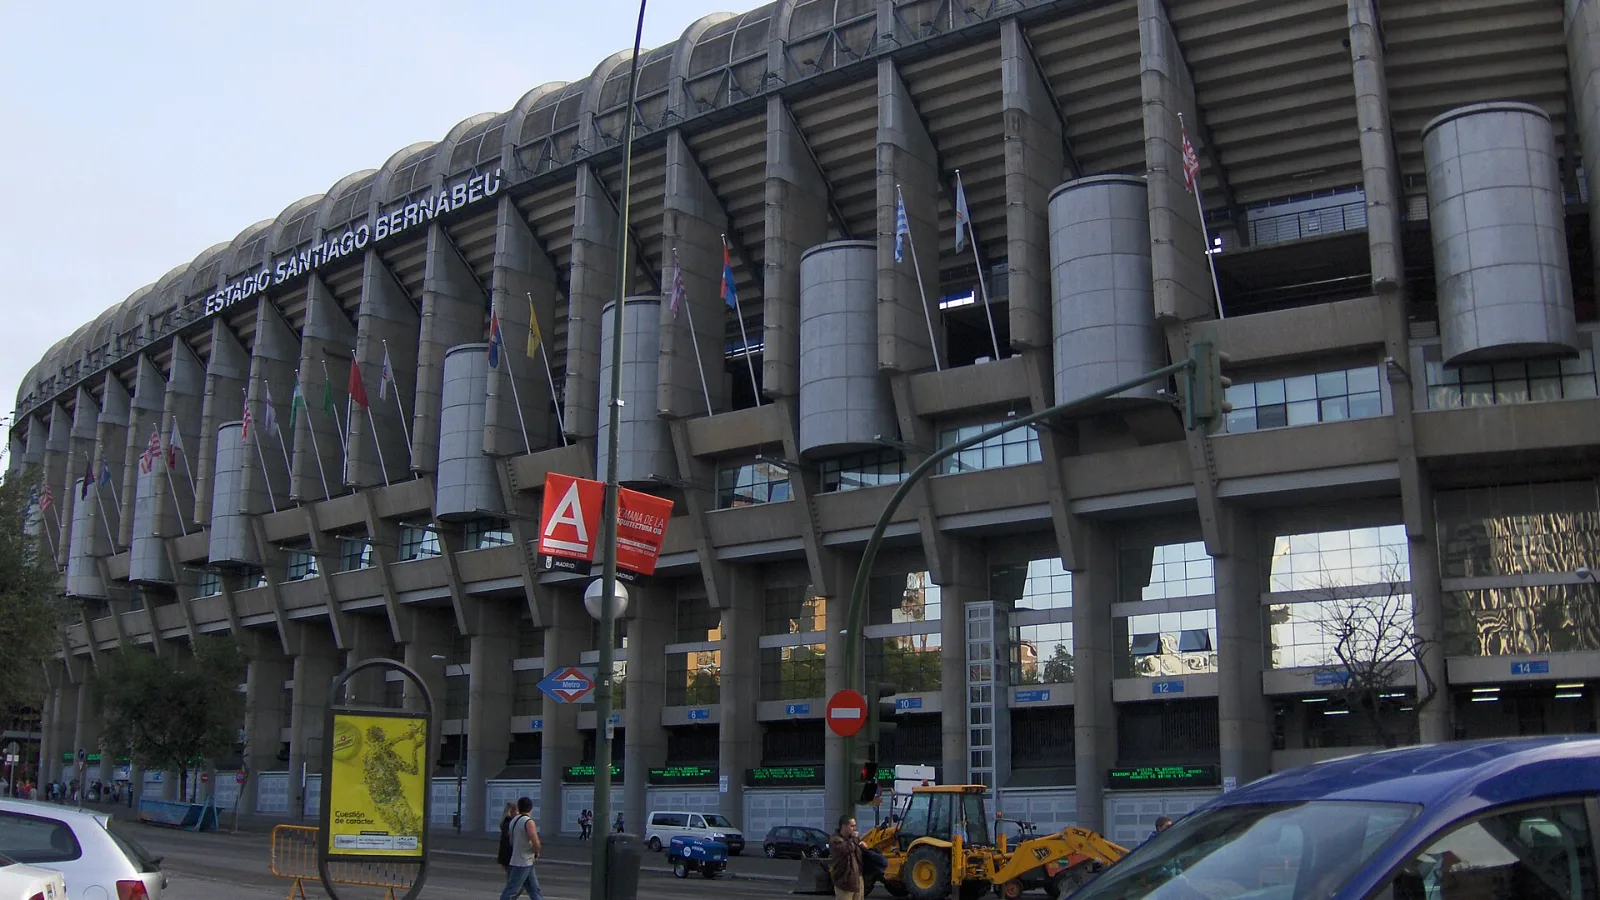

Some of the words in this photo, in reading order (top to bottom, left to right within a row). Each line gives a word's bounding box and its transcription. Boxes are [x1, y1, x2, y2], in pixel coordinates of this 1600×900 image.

[204, 268, 270, 317] ESTADIO
[275, 224, 370, 285] SANTIAGO
[375, 168, 501, 242] BERNABEU
[544, 480, 589, 542] A
[617, 517, 653, 533] RQUITECTURA
[643, 514, 654, 526] DE
[654, 517, 665, 529] LA
[1518, 663, 1530, 673] 14
[562, 681, 581, 689] Metro
[1158, 682, 1169, 693] 12
[900, 699, 909, 709] 10
[691, 710, 697, 719] 6
[789, 705, 795, 714] 8
[534, 720, 539, 728] 2
[335, 810, 366, 818] Cuestión
[1032, 846, 1051, 861] JCB
